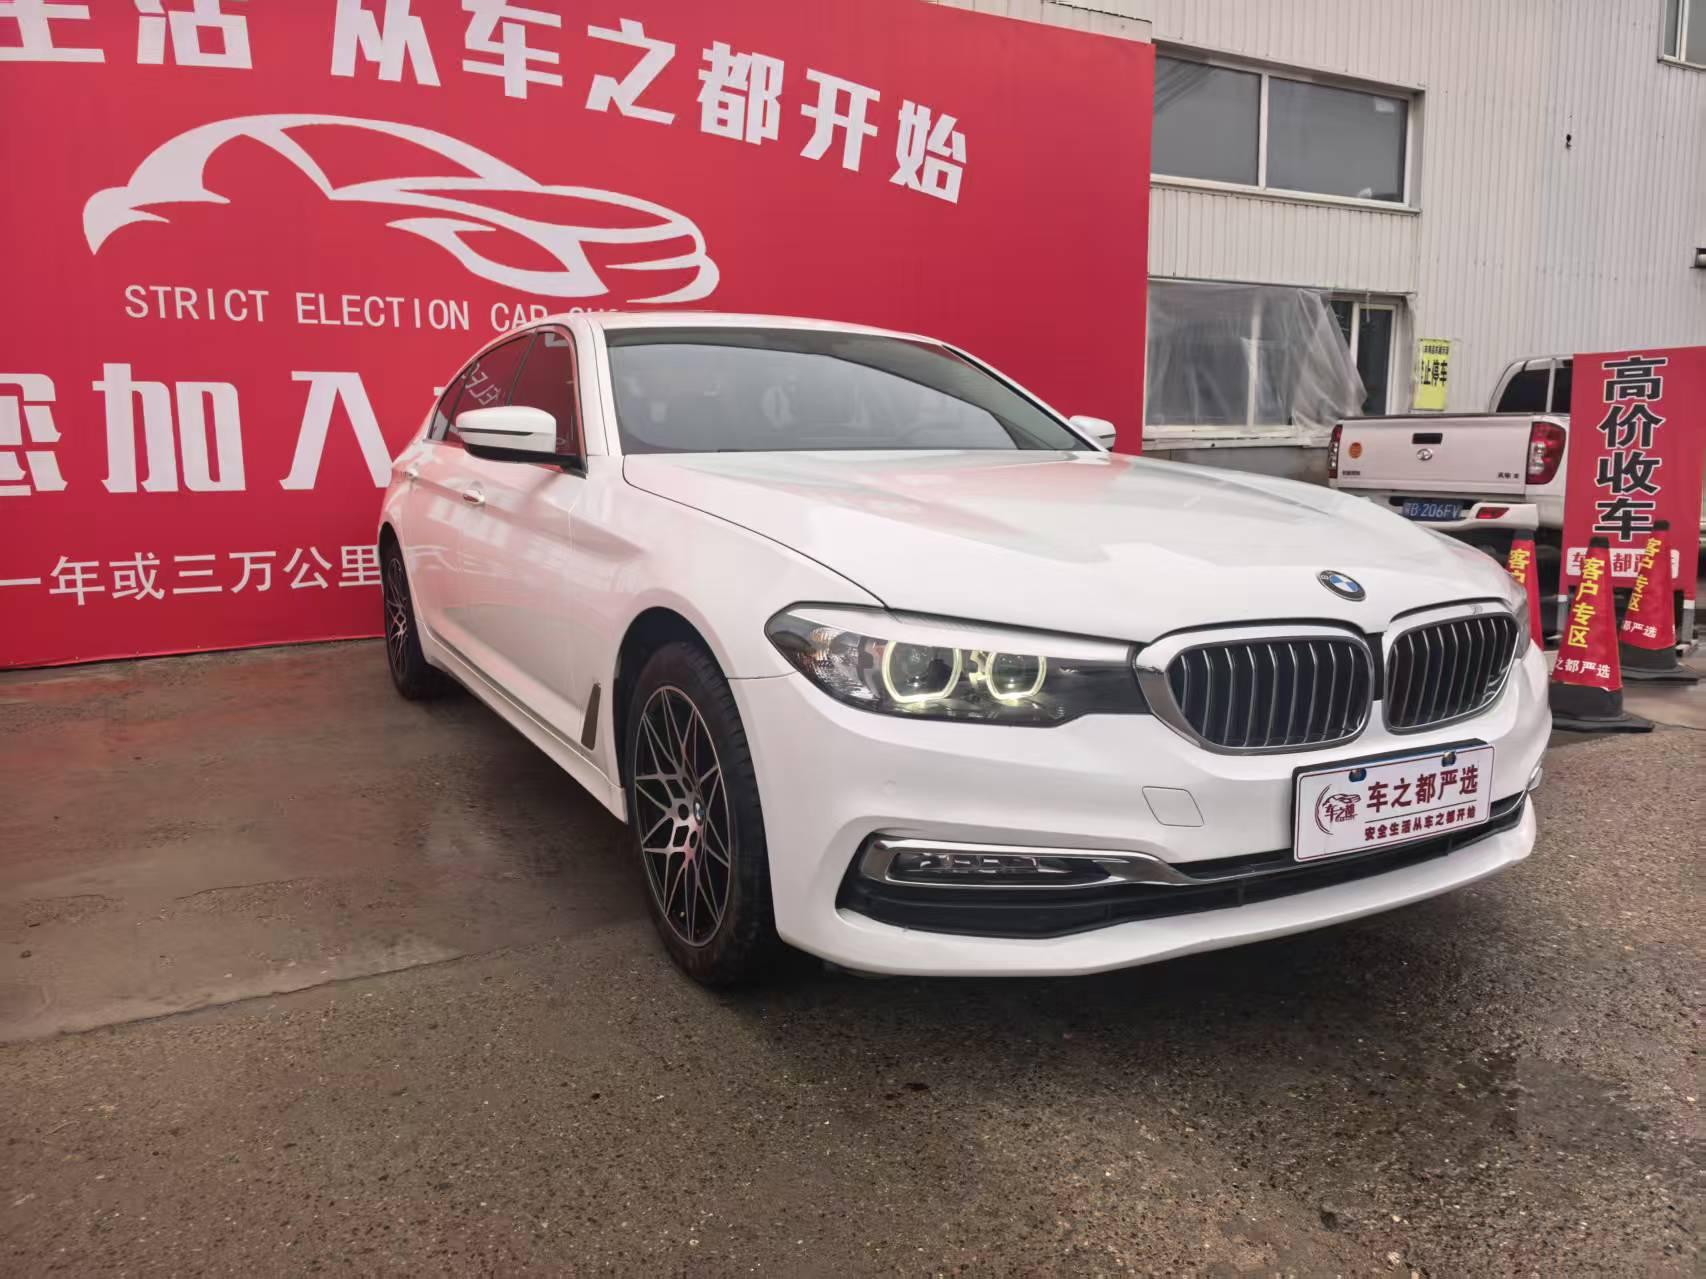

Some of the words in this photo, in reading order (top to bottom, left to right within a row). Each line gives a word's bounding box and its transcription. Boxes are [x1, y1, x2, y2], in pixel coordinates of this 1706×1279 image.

[124, 284, 269, 322] STRICT
[296, 292, 470, 331] ELECTION
[1593, 355, 1669, 542] 高价收车
[0, 544, 381, 606] 一年或三万公里
[1567, 556, 1606, 649] 客户专区
[1366, 763, 1479, 814] 车之都严选
[1364, 805, 1476, 841] 安全生活从车之都开始
